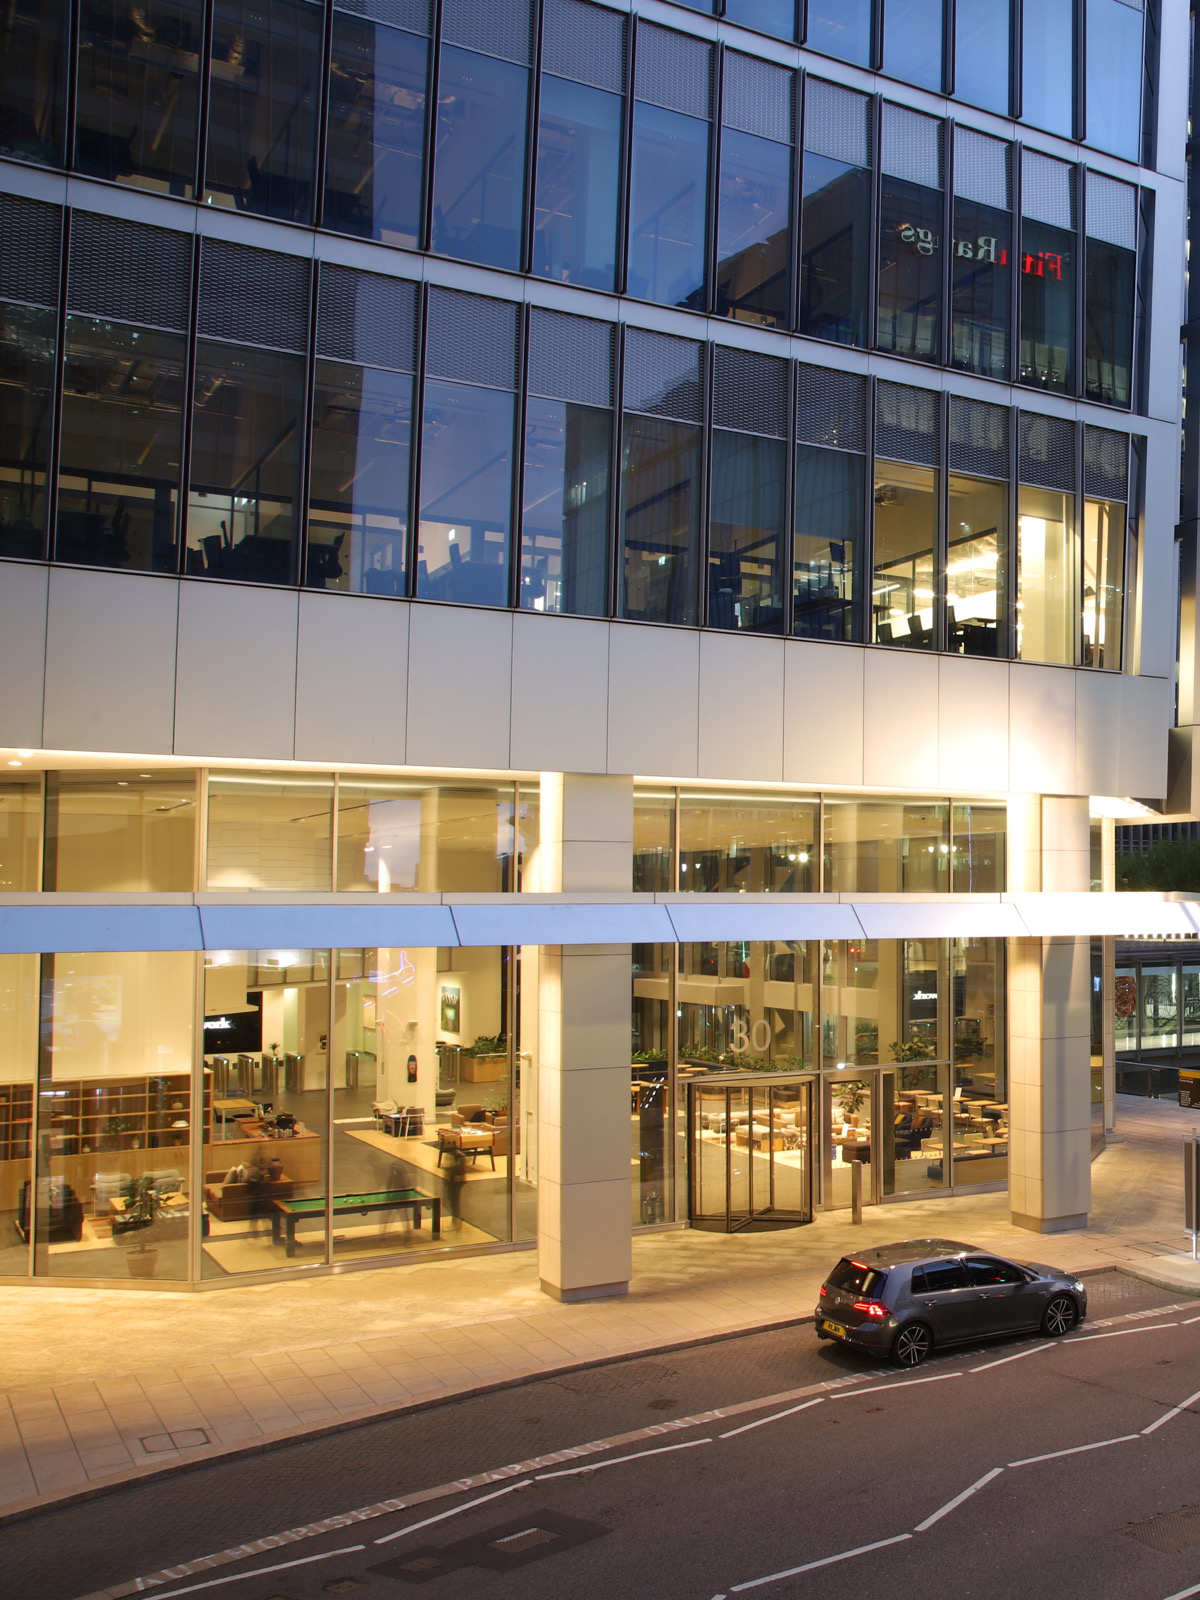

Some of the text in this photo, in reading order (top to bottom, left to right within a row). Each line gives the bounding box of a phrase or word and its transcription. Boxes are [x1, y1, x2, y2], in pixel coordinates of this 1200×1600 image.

[729, 1019, 771, 1052] 30
[135, 1409, 726, 1590] AUTHORISED PARKING ONLY
